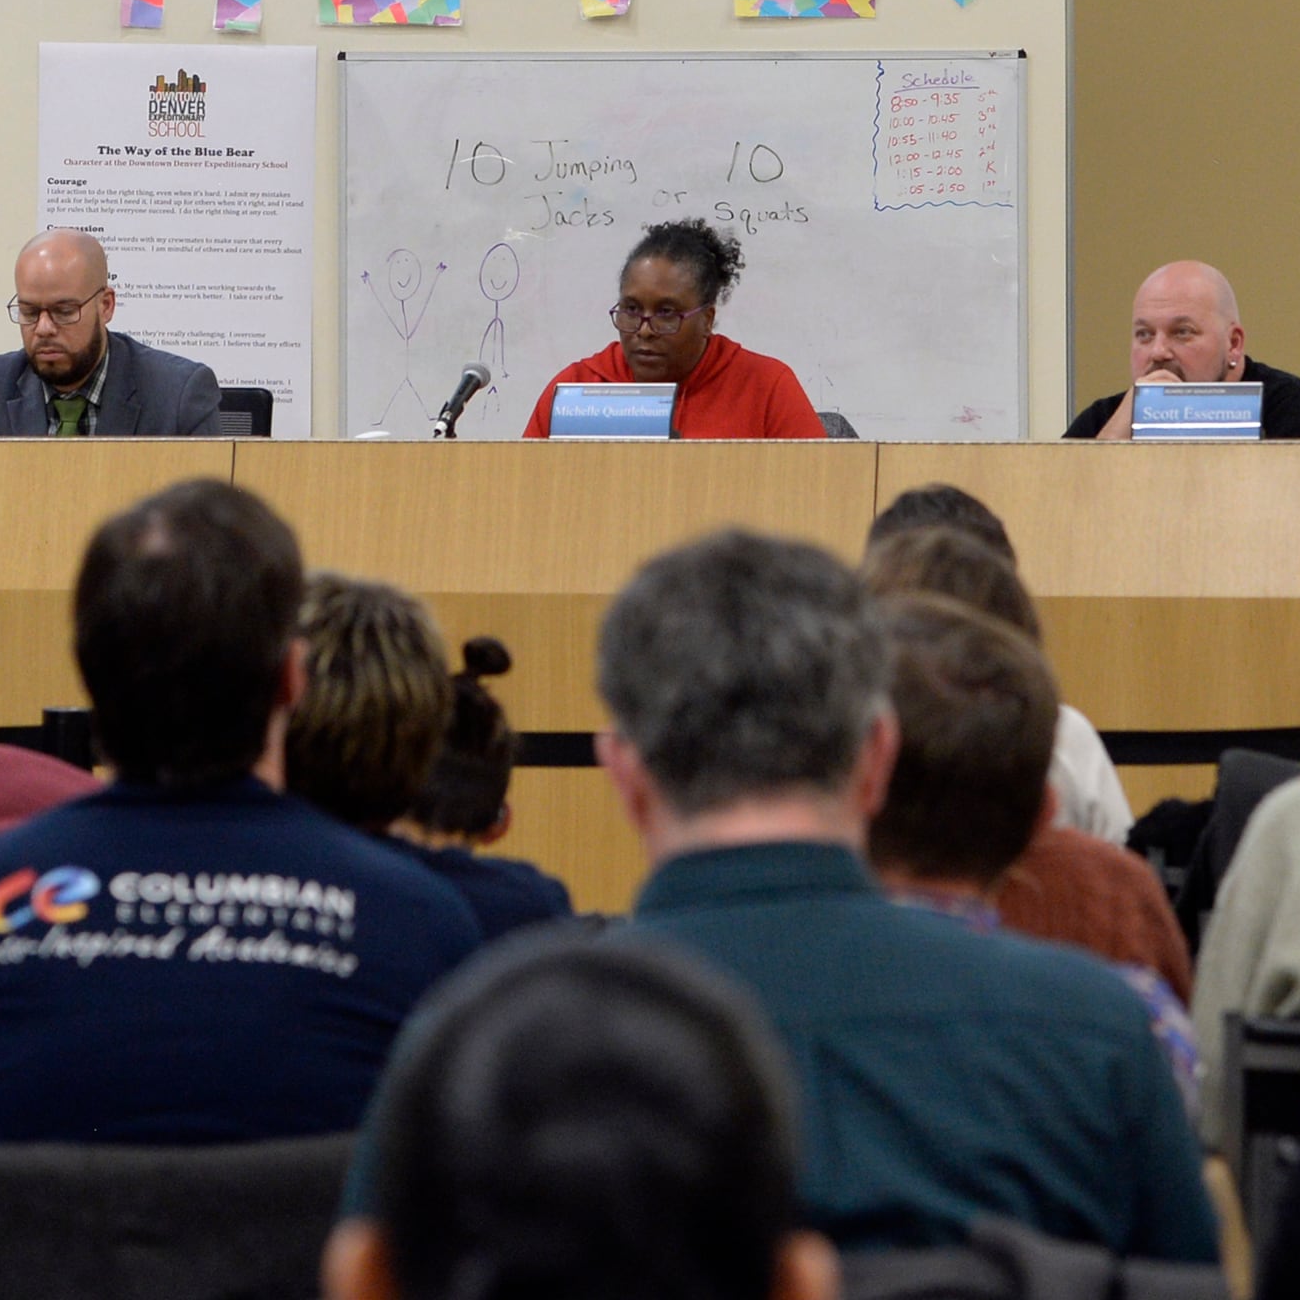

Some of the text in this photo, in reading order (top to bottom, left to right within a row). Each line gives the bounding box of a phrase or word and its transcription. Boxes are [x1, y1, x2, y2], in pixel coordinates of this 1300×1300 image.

[902, 68, 974, 88] Schedule
[148, 100, 206, 115] DENVER
[148, 121, 206, 138] SCHOOL
[97, 146, 255, 158] The Way of the Blue Bear
[63, 159, 102, 167] Character
[114, 159, 127, 167] the
[129, 159, 172, 168] Downtown
[174, 160, 203, 168] Denver
[204, 160, 260, 171] Expeditionary
[262, 161, 288, 169] School
[446, 138, 784, 189] 10 Jumping 10
[985, 160, 997, 174] K
[47, 177, 88, 187] Courage
[524, 188, 810, 236] Jacks or Squats
[553, 405, 670, 418] Michelle Quattlebaum
[1142, 406, 1252, 421] Scott Esserman
[108, 870, 357, 920] COLUMBIAN
